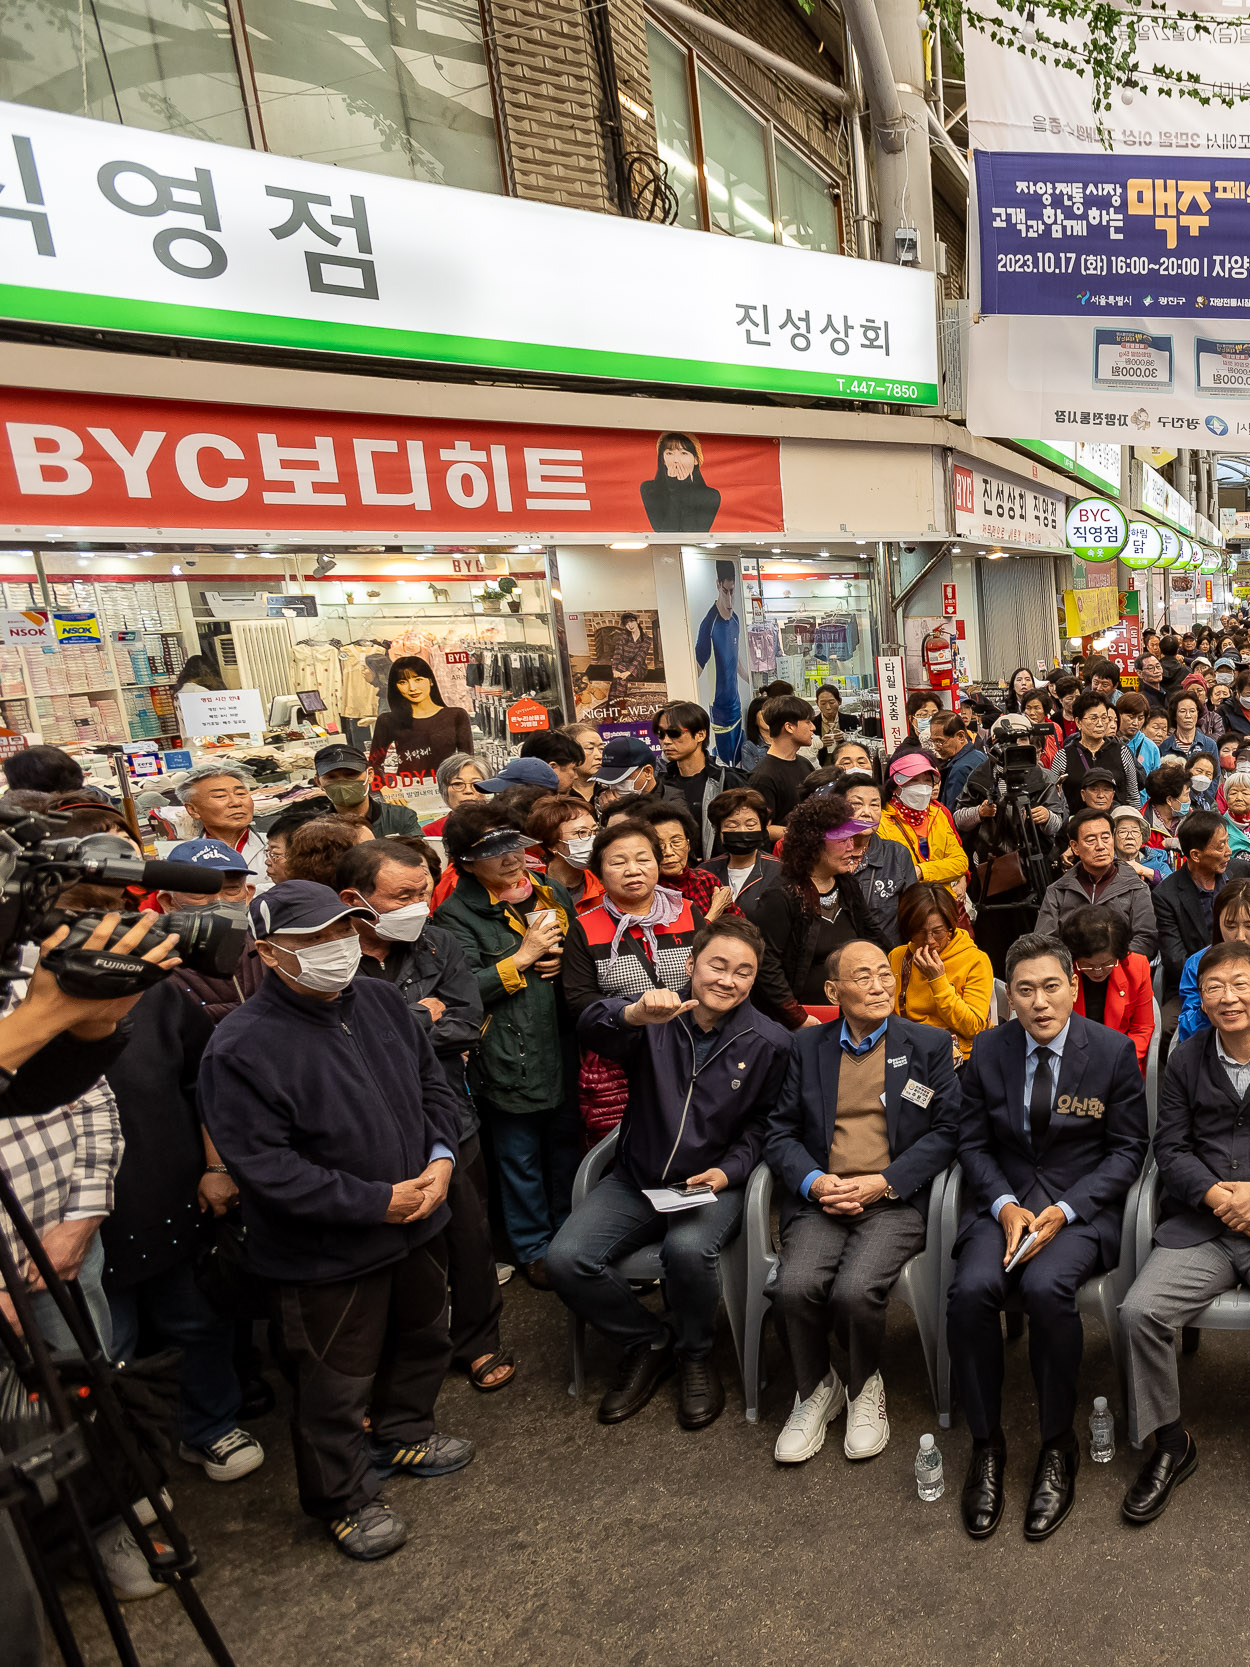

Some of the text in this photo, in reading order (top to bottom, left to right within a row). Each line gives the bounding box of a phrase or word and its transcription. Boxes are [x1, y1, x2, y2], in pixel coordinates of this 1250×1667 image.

[1127, 178, 1212, 249] 맥주
[998, 253, 1076, 274] 2023.10.17
[1081, 254, 1107, 276] (화)
[1111, 256, 1200, 276] 16:00~20:00
[1090, 294, 1132, 307] 서울특별시
[1158, 295, 1186, 307] 광진구
[735, 303, 891, 357] 진성상회
[836, 378, 919, 399] T.447-7850
[5, 422, 592, 513] BYC보디히트
[956, 473, 973, 509] BYC
[982, 477, 1057, 530] 진성상회 직영점
[1079, 508, 1111, 522] BYC
[1073, 525, 1118, 543] 직영점
[9, 628, 47, 637] NSOK
[62, 626, 93, 635] NSOK
[448, 653, 468, 662] BYC
[885, 662, 896, 689] 타월
[582, 707, 620, 720] NIGHT
[887, 694, 899, 721] 맞춤
[371, 769, 427, 791] BODY
[95, 958, 145, 972] FUJINON
[1056, 1094, 1105, 1119] 오신환
